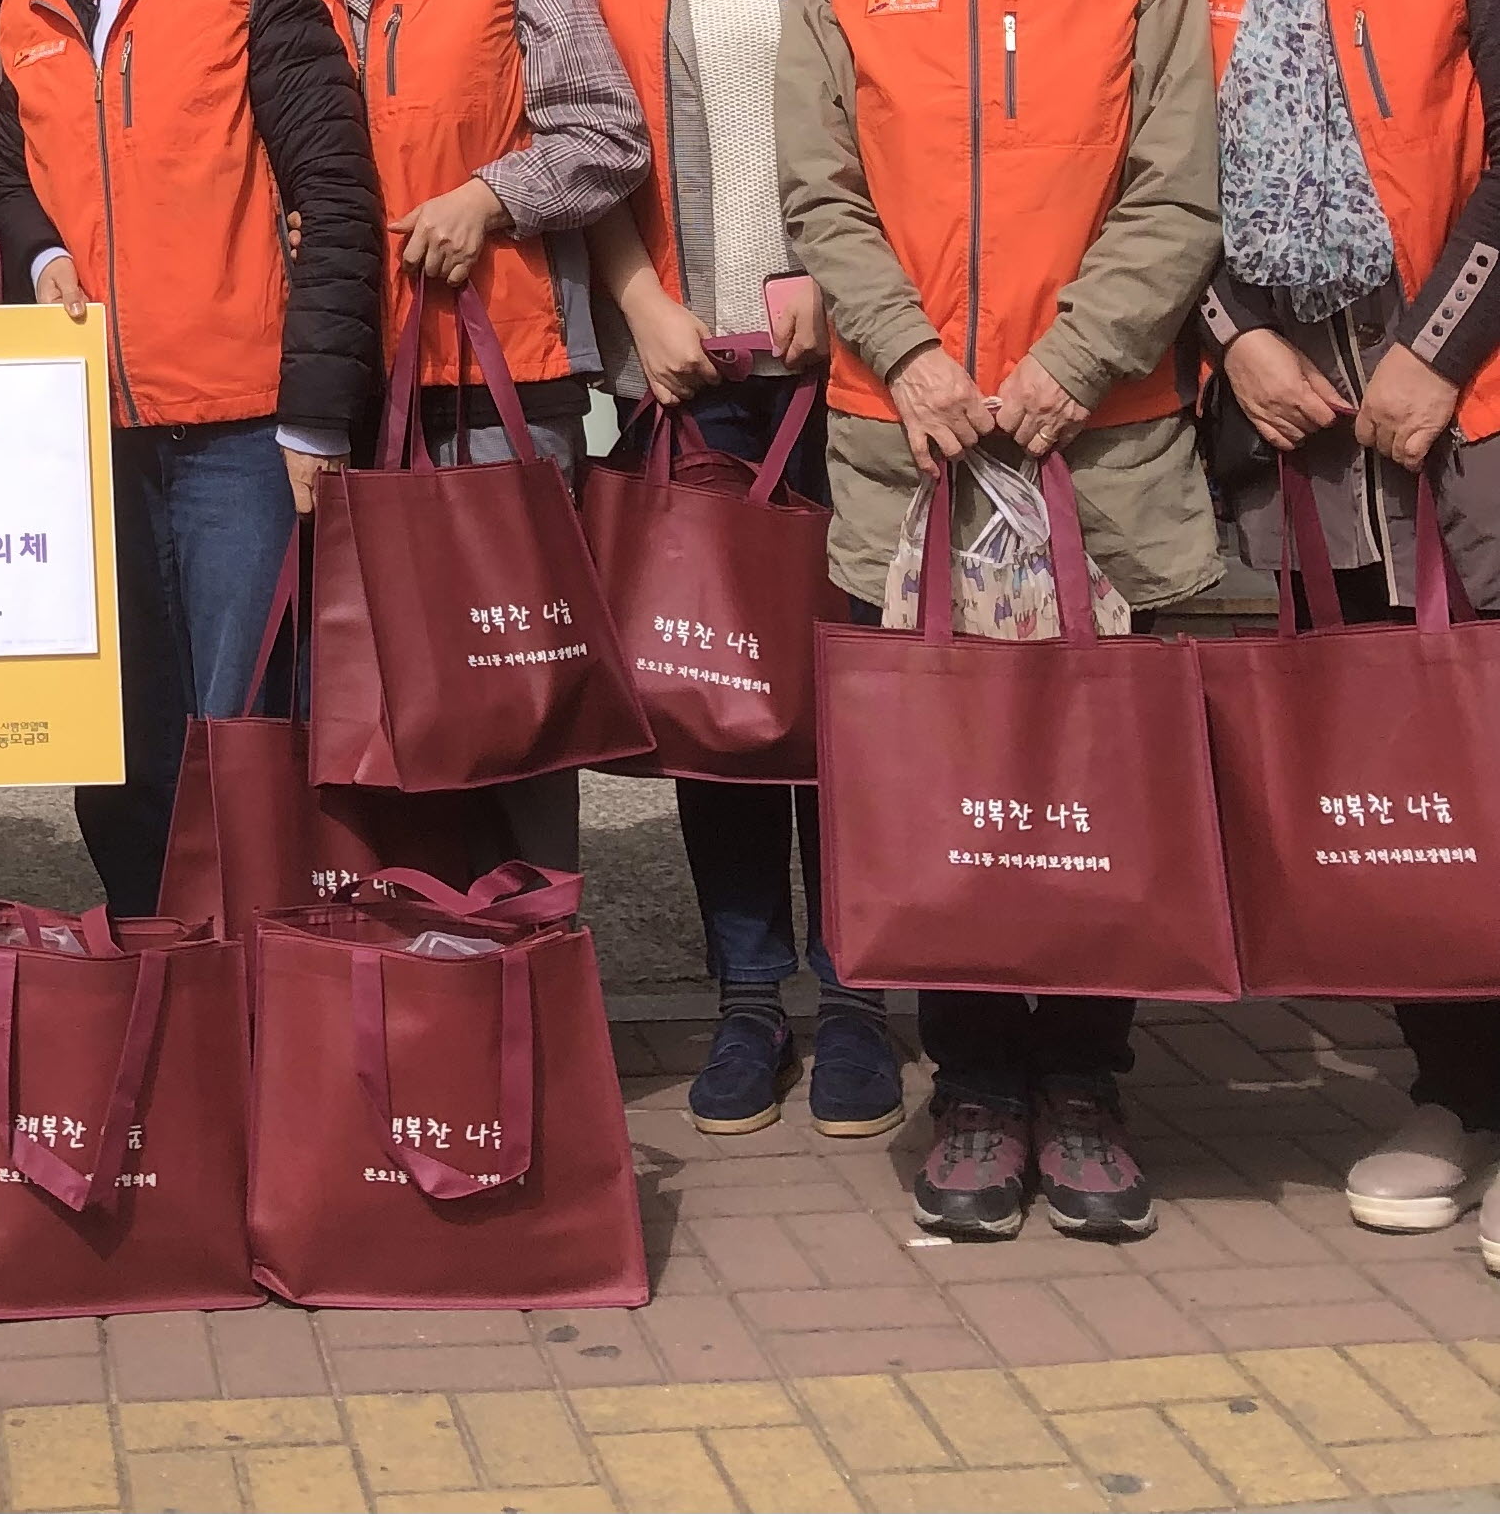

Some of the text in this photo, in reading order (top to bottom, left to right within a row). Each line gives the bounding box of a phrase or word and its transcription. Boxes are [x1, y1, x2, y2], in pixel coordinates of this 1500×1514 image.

[470, 598, 572, 634] 행복찬 나눔
[653, 615, 759, 660] 행복찬 나눔
[960, 797, 1091, 833] 행복찬 나눔
[1319, 791, 1453, 826] 행복찬 나눔
